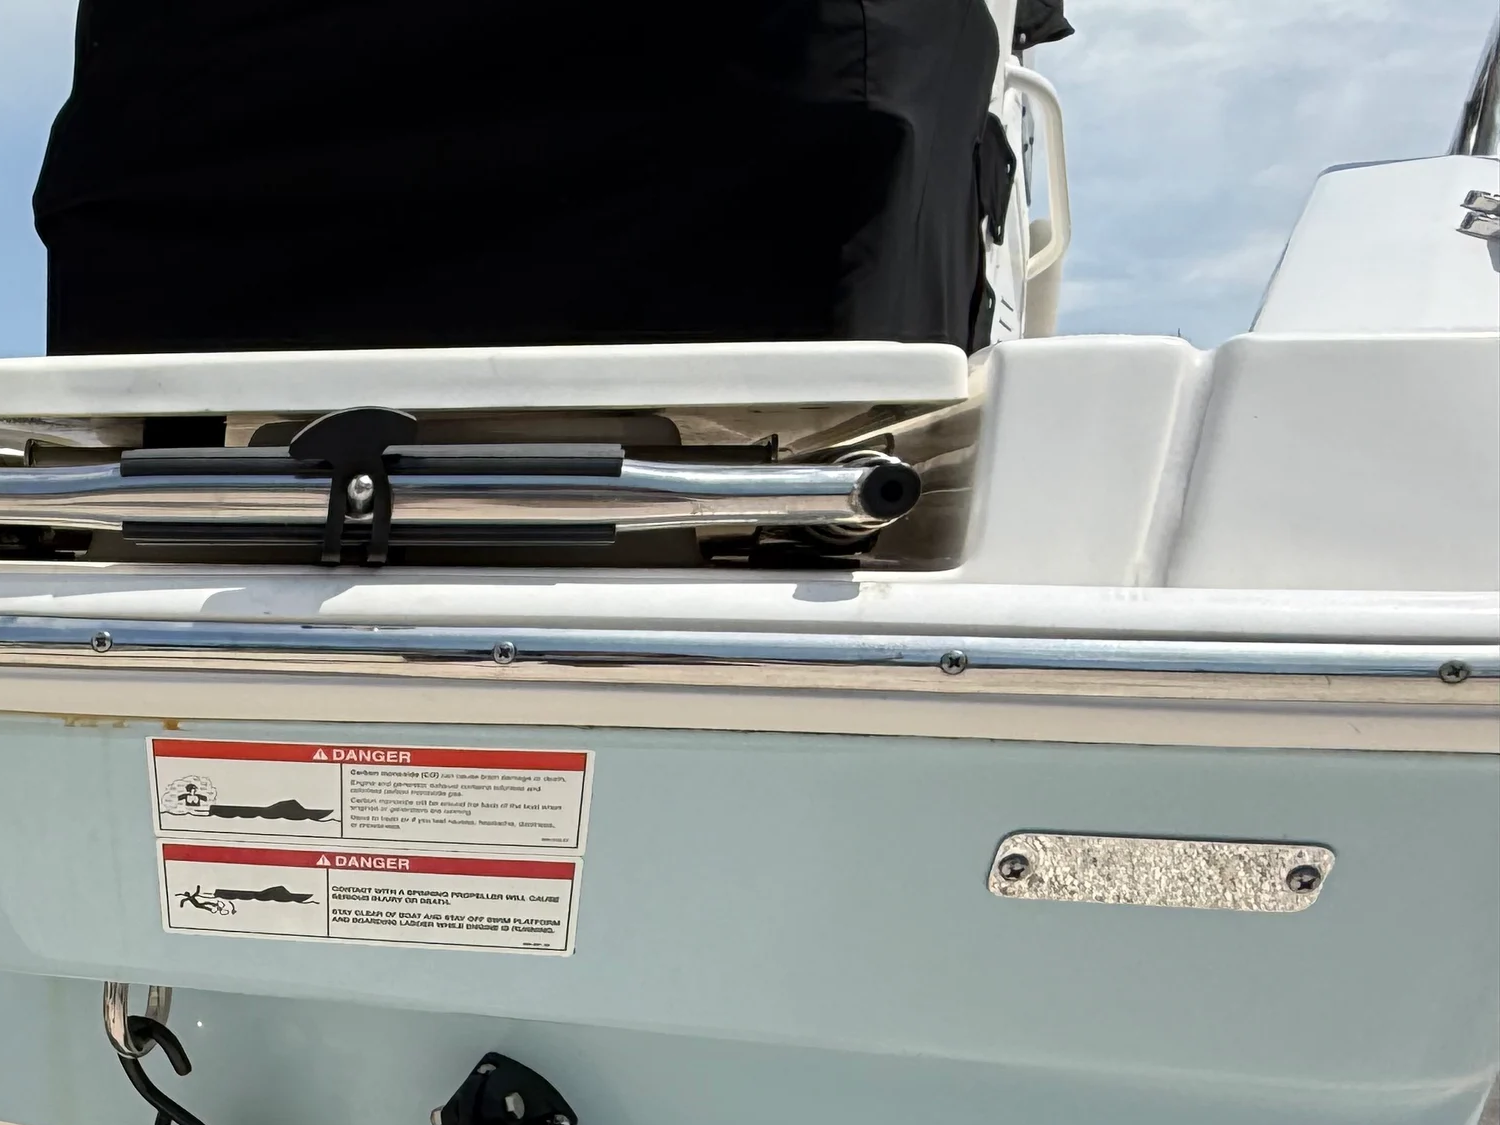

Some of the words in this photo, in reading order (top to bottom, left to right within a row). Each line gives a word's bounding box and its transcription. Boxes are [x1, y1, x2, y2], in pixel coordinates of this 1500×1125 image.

[332, 749, 411, 763] DANGER
[335, 856, 410, 870] DANGER
[331, 886, 372, 894] CONTACT
[451, 892, 503, 900] PROPELLER
[529, 895, 559, 903] CAUSE
[513, 918, 560, 926] PLATFORM
